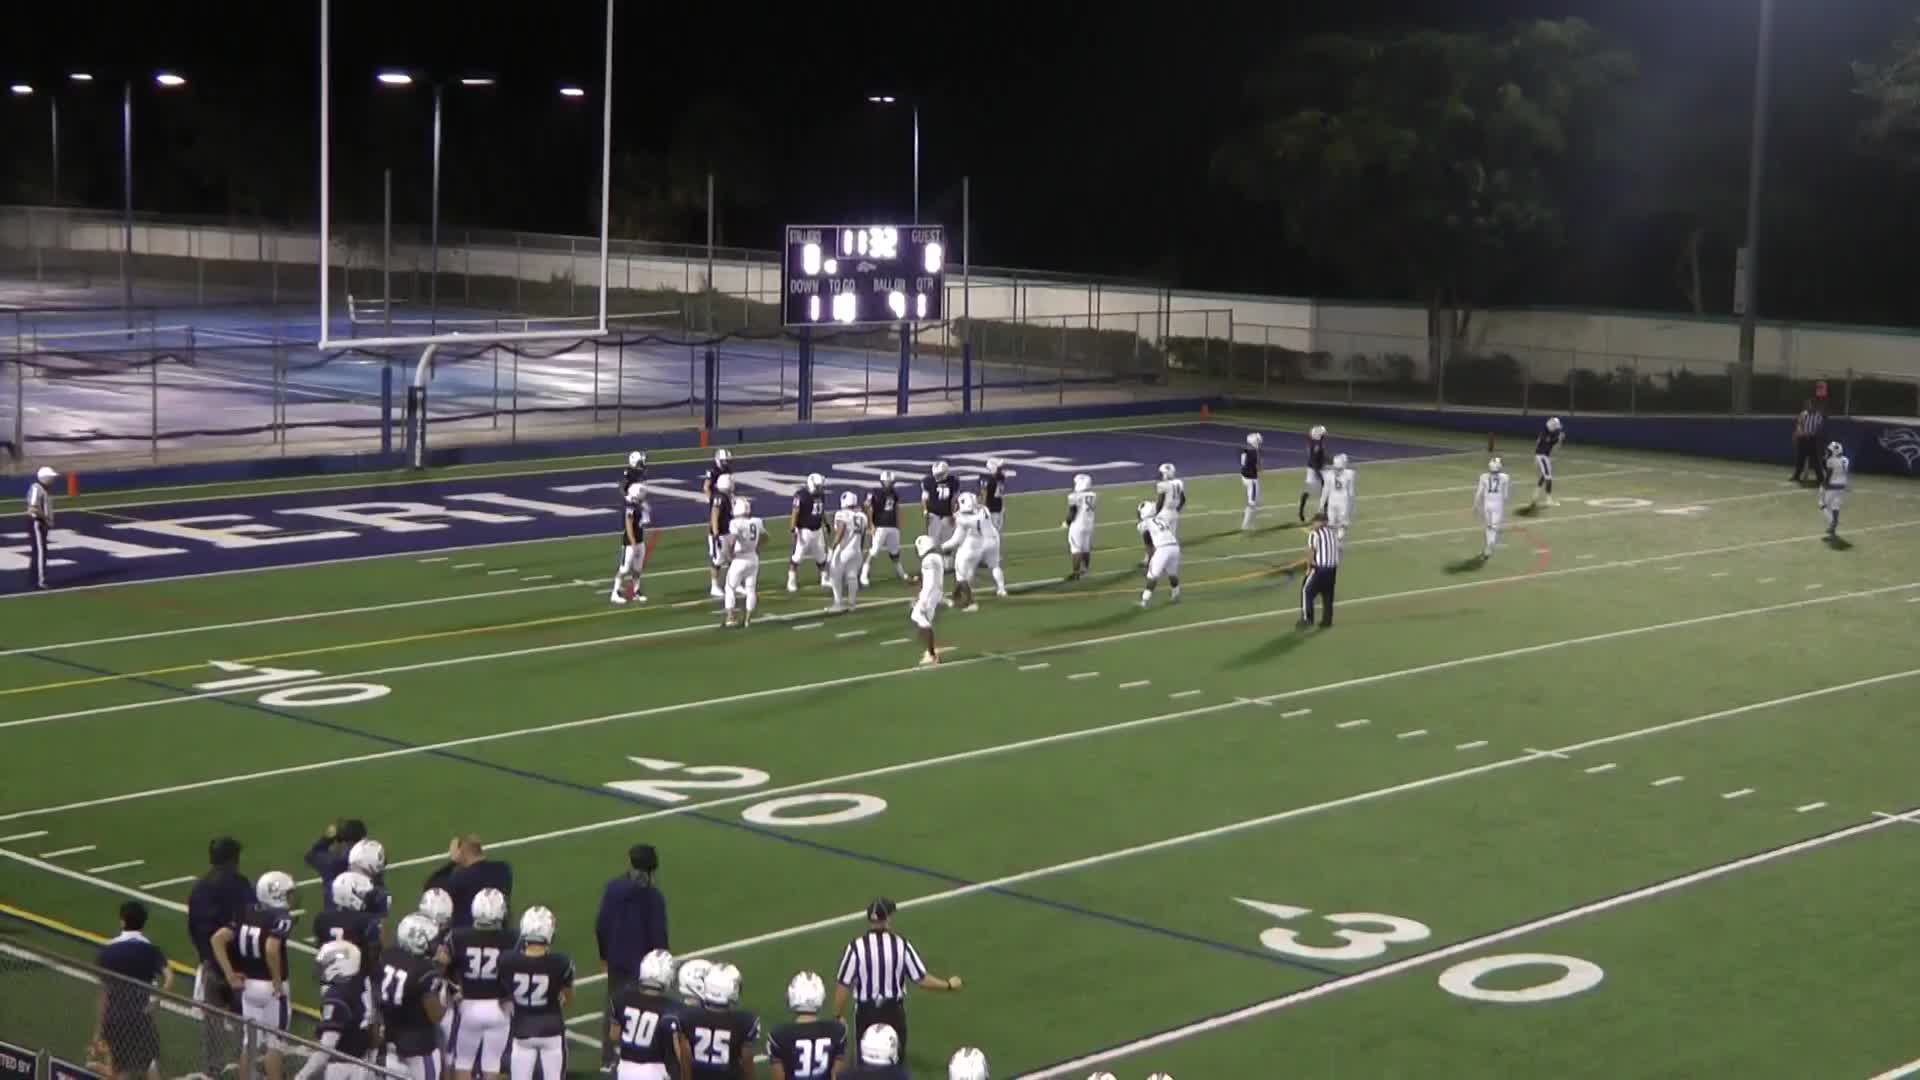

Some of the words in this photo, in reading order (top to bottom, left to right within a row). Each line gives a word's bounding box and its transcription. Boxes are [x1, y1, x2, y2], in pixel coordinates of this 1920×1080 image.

[912, 230, 940, 242] GUEST
[790, 279, 819, 293] DOWN
[829, 279, 840, 293] TO
[842, 279, 855, 292] GO
[916, 277, 934, 290] QTR
[602, 764, 888, 826] 20
[464, 947, 500, 979] 32
[1259, 912, 1605, 1003] 30
[513, 973, 550, 1007] 22
[621, 1006, 659, 1047] 30
[694, 1027, 731, 1064] 25
[794, 1037, 832, 1077] 35
